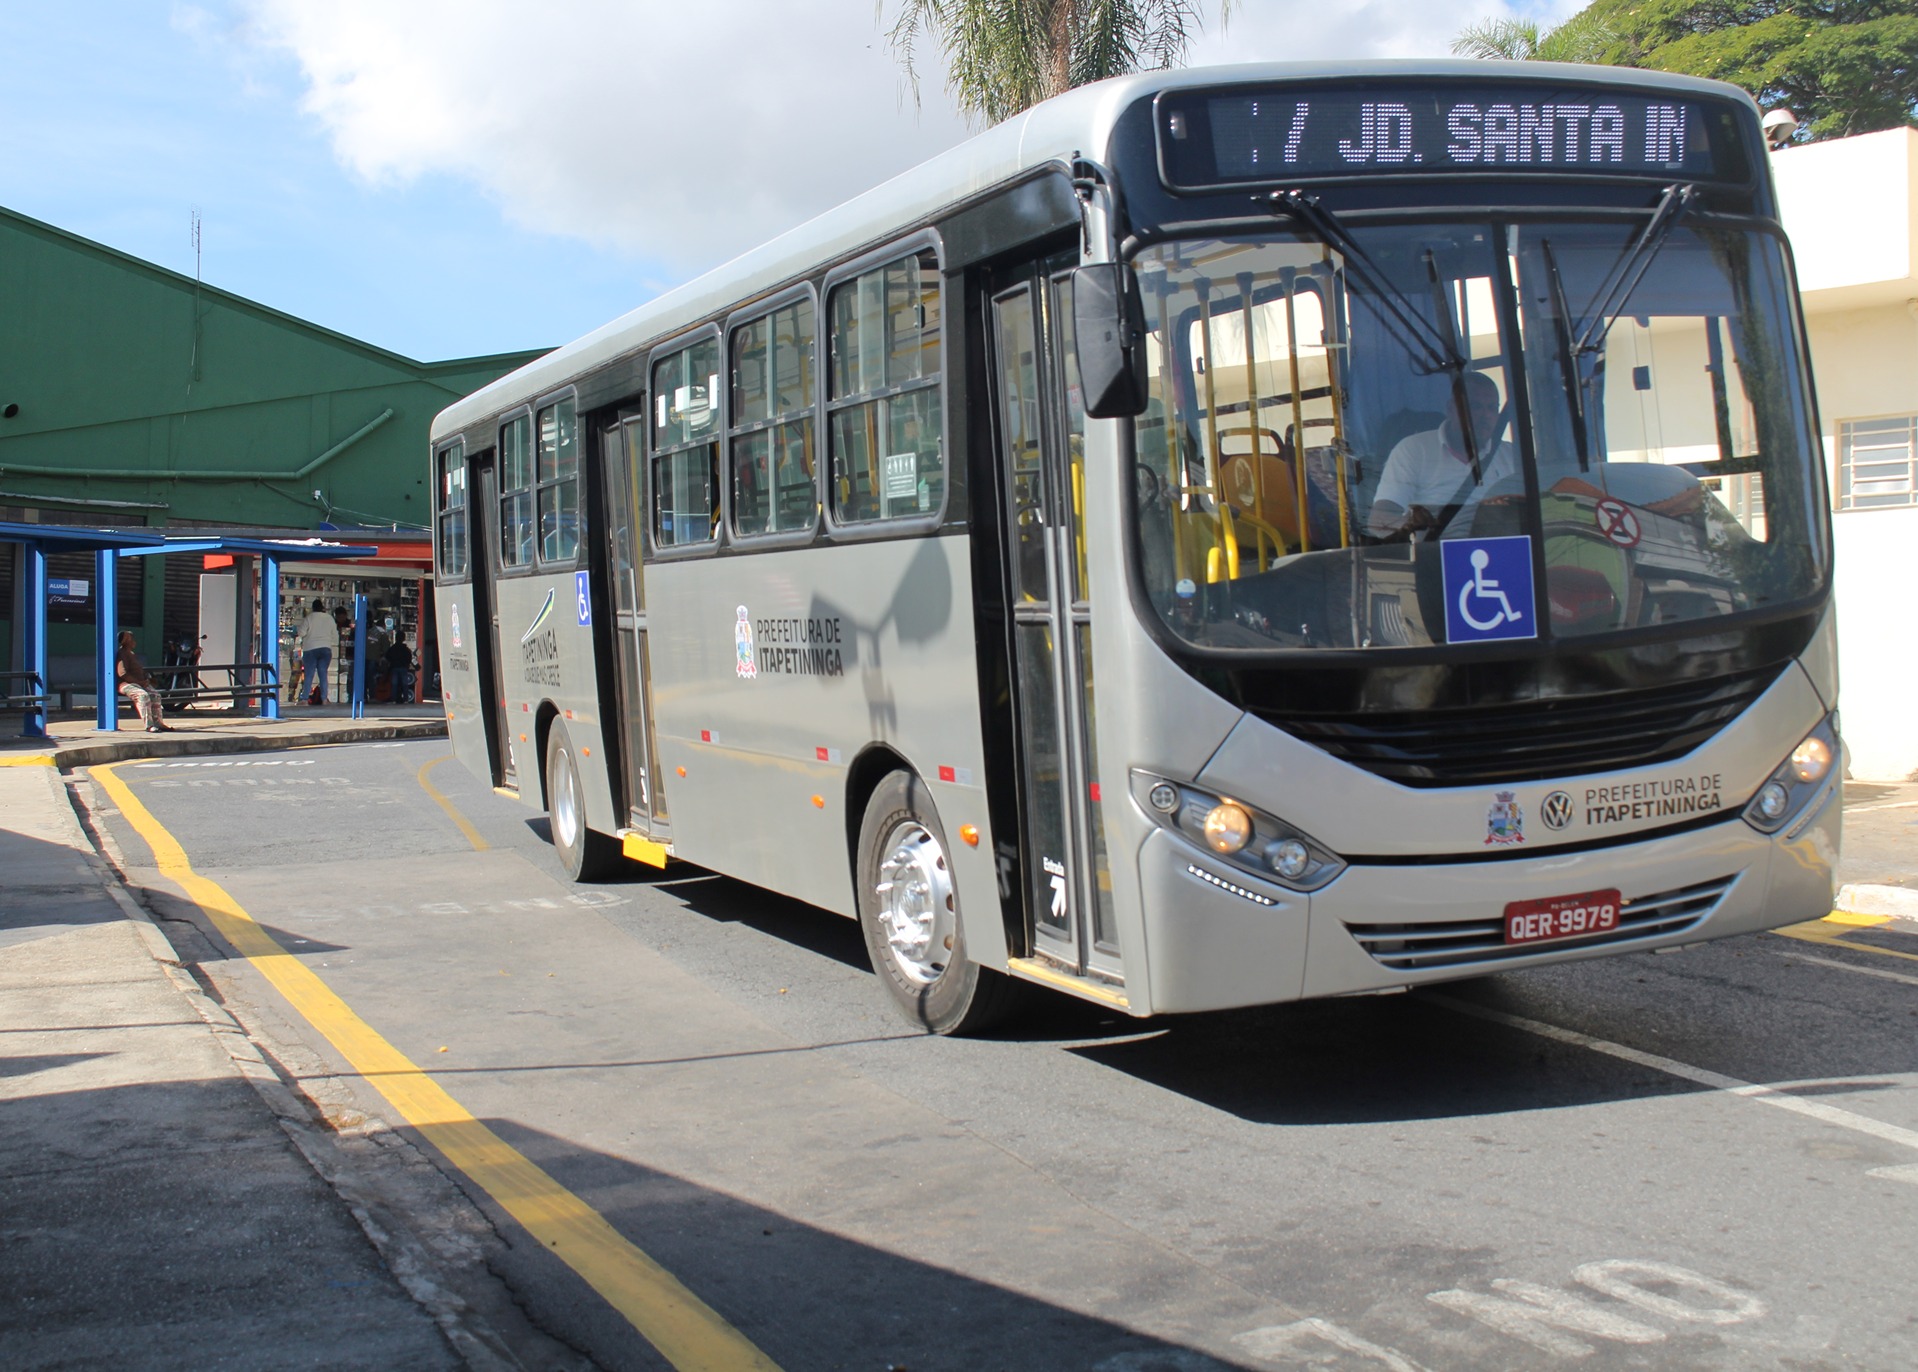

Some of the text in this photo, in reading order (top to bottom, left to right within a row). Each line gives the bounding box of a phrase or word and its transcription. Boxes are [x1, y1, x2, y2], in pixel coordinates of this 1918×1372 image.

[1338, 102, 1423, 163] JD.
[1446, 103, 1625, 163] SANTA
[757, 618, 842, 644] PREFEITURA DE
[759, 648, 844, 677] ITAPETININGA
[1585, 773, 1722, 805] PREFEITURA DE
[1586, 793, 1721, 825] ITAPETININGA
